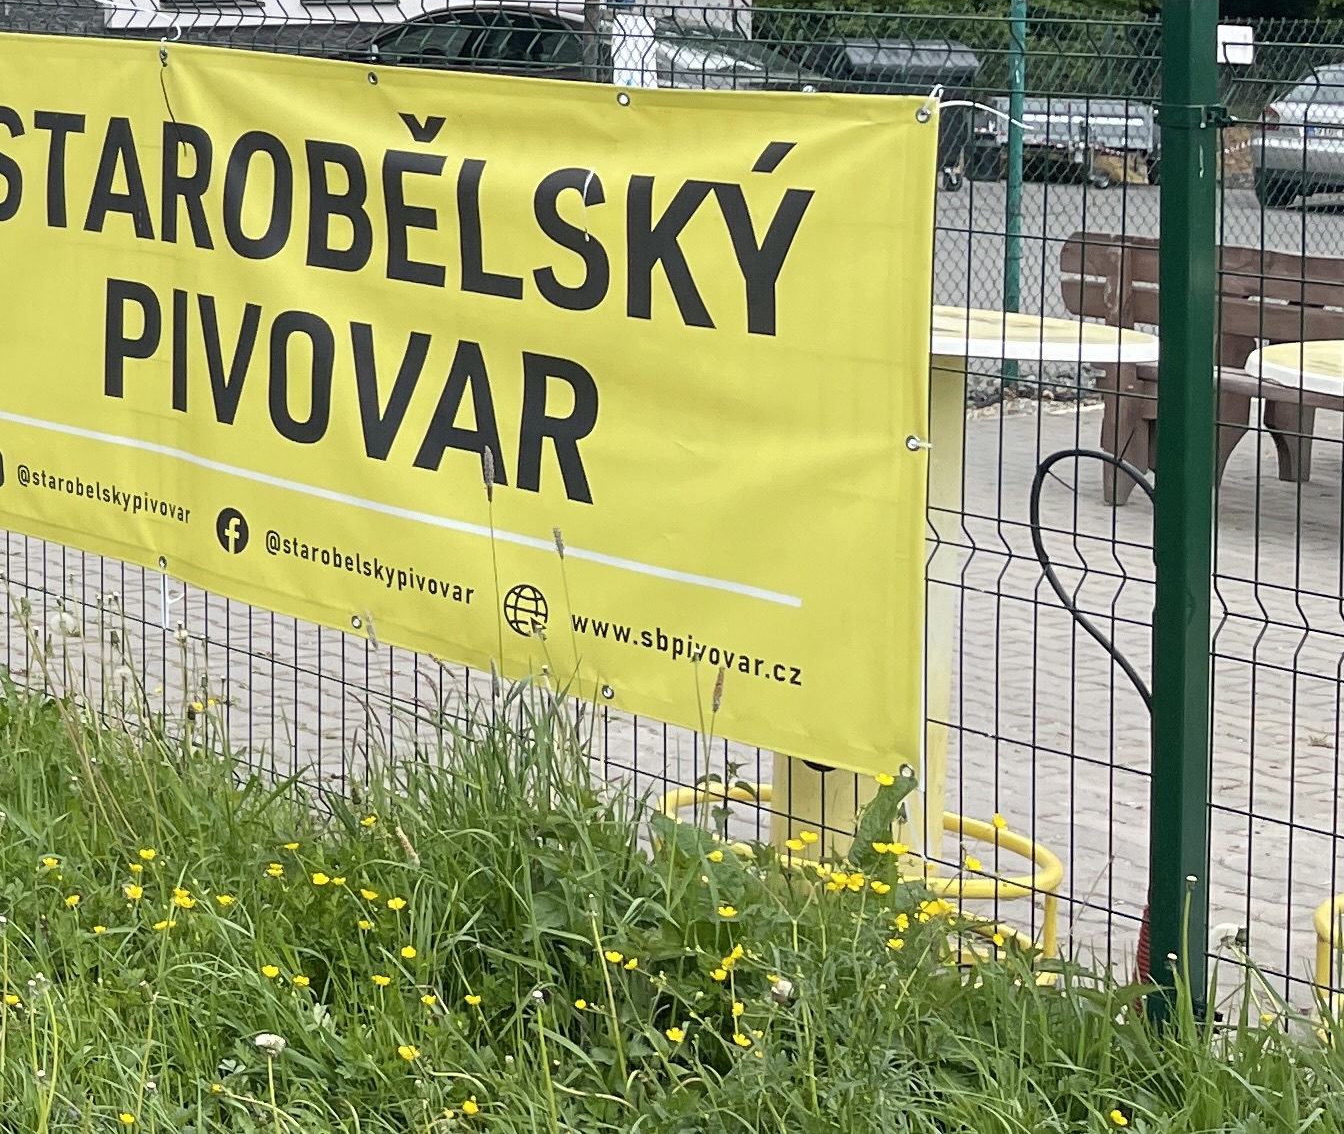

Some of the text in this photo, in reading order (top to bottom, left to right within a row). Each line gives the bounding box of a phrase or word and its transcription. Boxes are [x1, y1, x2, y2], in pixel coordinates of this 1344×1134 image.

[104, 277, 600, 505] PIVOVAR
[17, 464, 191, 524] @starobelskypivovar
[265, 529, 475, 604] @starobelskypivovar
